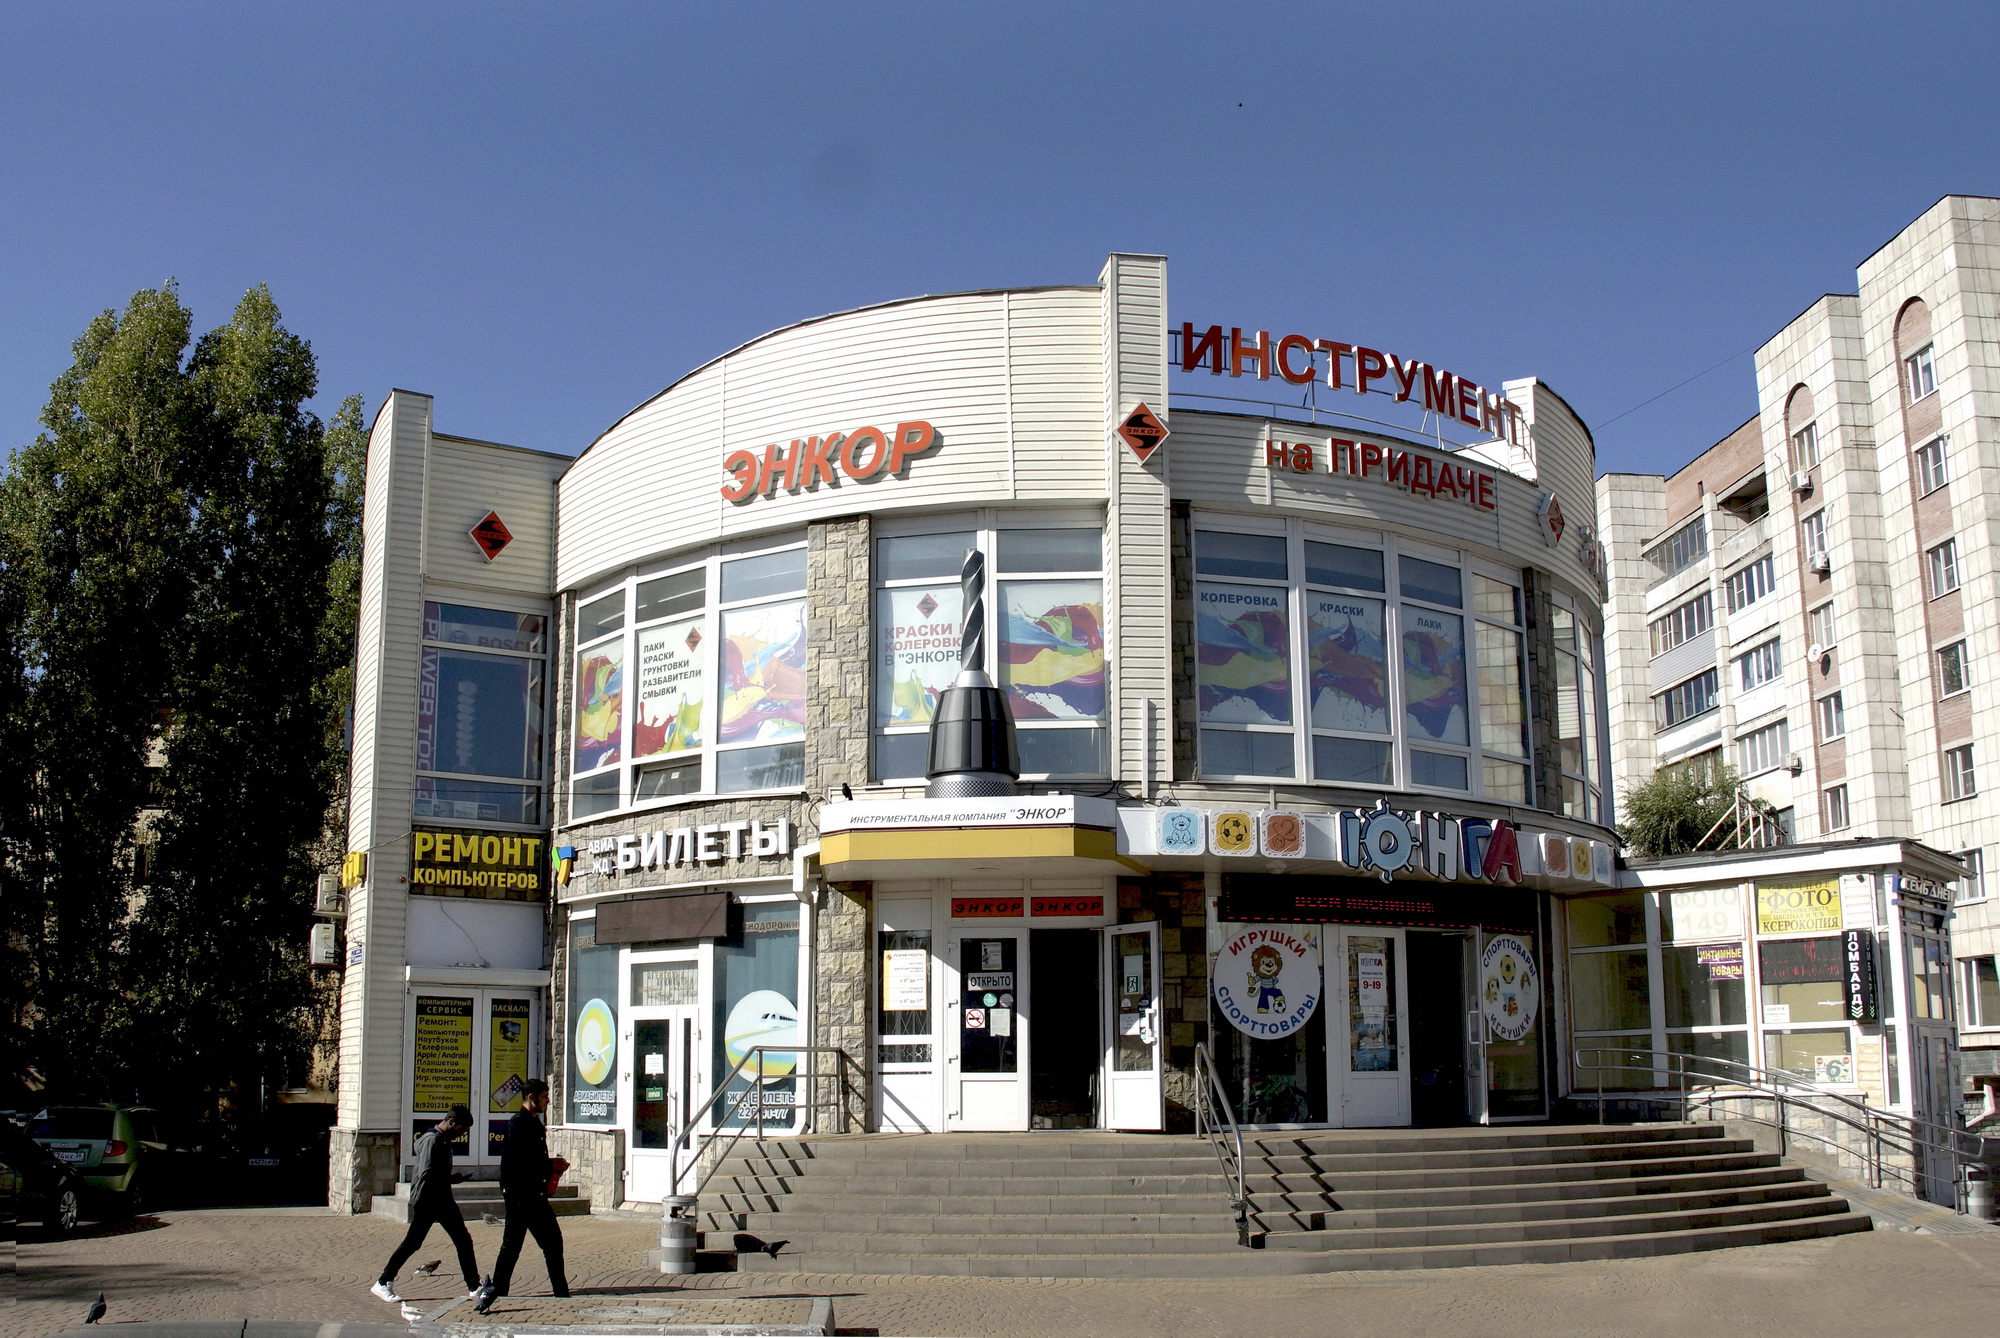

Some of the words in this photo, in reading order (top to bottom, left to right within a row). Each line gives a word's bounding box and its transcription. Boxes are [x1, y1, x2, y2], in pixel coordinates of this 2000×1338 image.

[1181, 322, 1522, 446] ИНСТРУМЕНТ
[721, 420, 937, 502] ЭНКОР
[1264, 439, 1313, 471] на
[1327, 437, 1495, 511] ПРИДАЧЕ
[1200, 592, 1278, 607] КОЛЕРОВКА
[1319, 603, 1364, 617] КРАСКИ
[1417, 617, 1442, 630] ЛАКИ
[884, 623, 952, 639] КРАСКИ
[643, 641, 665, 653] ЛАКИ
[884, 637, 961, 652] КОЛЕРОВК
[643, 651, 675, 665] КРАСКИ
[885, 655, 894, 666] В
[643, 659, 690, 676] ГРУНТОВКИ
[643, 669, 702, 688] РАЗБАВИТЕЛИ
[642, 685, 677, 700] СМЫВКИ
[850, 813, 951, 824] ИНСТРУМЕНТАЛЬНАЯ
[953, 812, 1006, 822] КОМПАНИЯ
[414, 831, 541, 866] РЕМОНТ
[588, 838, 617, 855] АВИА
[617, 817, 790, 870] БИЛЕТЫ
[592, 859, 612, 876] ЖД
[413, 868, 538, 890] КОМПЬЮТЕРОВ
[1768, 881, 1830, 892] СРОЧНОЕ
[1767, 889, 1832, 909] ФОТО
[955, 903, 1021, 913] ЭНКОР
[1034, 902, 1102, 911] ЭНКОР
[1763, 917, 1839, 932] КСЕРОКОПИЯ
[1228, 929, 1306, 959] ИГРУШКИ
[1483, 939, 1537, 977] СПОРТТОВАРЫ
[1700, 947, 1742, 960] ИНТИМНЫЕ
[1712, 965, 1743, 976] ТОВАРЫ
[1848, 932, 1863, 1005] ЛОМБАРД
[970, 976, 1011, 987] ОТКРЫТО
[1363, 980, 1381, 990] 9-19
[418, 998, 471, 1006] КОМПЬЮТЕРНЫЙ
[492, 1004, 529, 1013] ПАСКАЛЬ
[427, 1006, 463, 1014] СЕРВИС
[1218, 986, 1316, 1035] СПОРТТОВАРЫ
[419, 1017, 457, 1026] Ремонт:
[1491, 1013, 1531, 1038] ИГРУШКИ
[418, 1028, 469, 1037] Компьютеров
[418, 1036, 459, 1044] Ноутбуков
[418, 1043, 459, 1052] Телефонов
[417, 1051, 437, 1059] Apple
[441, 1051, 469, 1059] Android
[417, 1066, 466, 1074] Телевизоров
[416, 1074, 431, 1082] Игр.
[573, 1090, 616, 1103] АВИАБИЛЕТЫ
